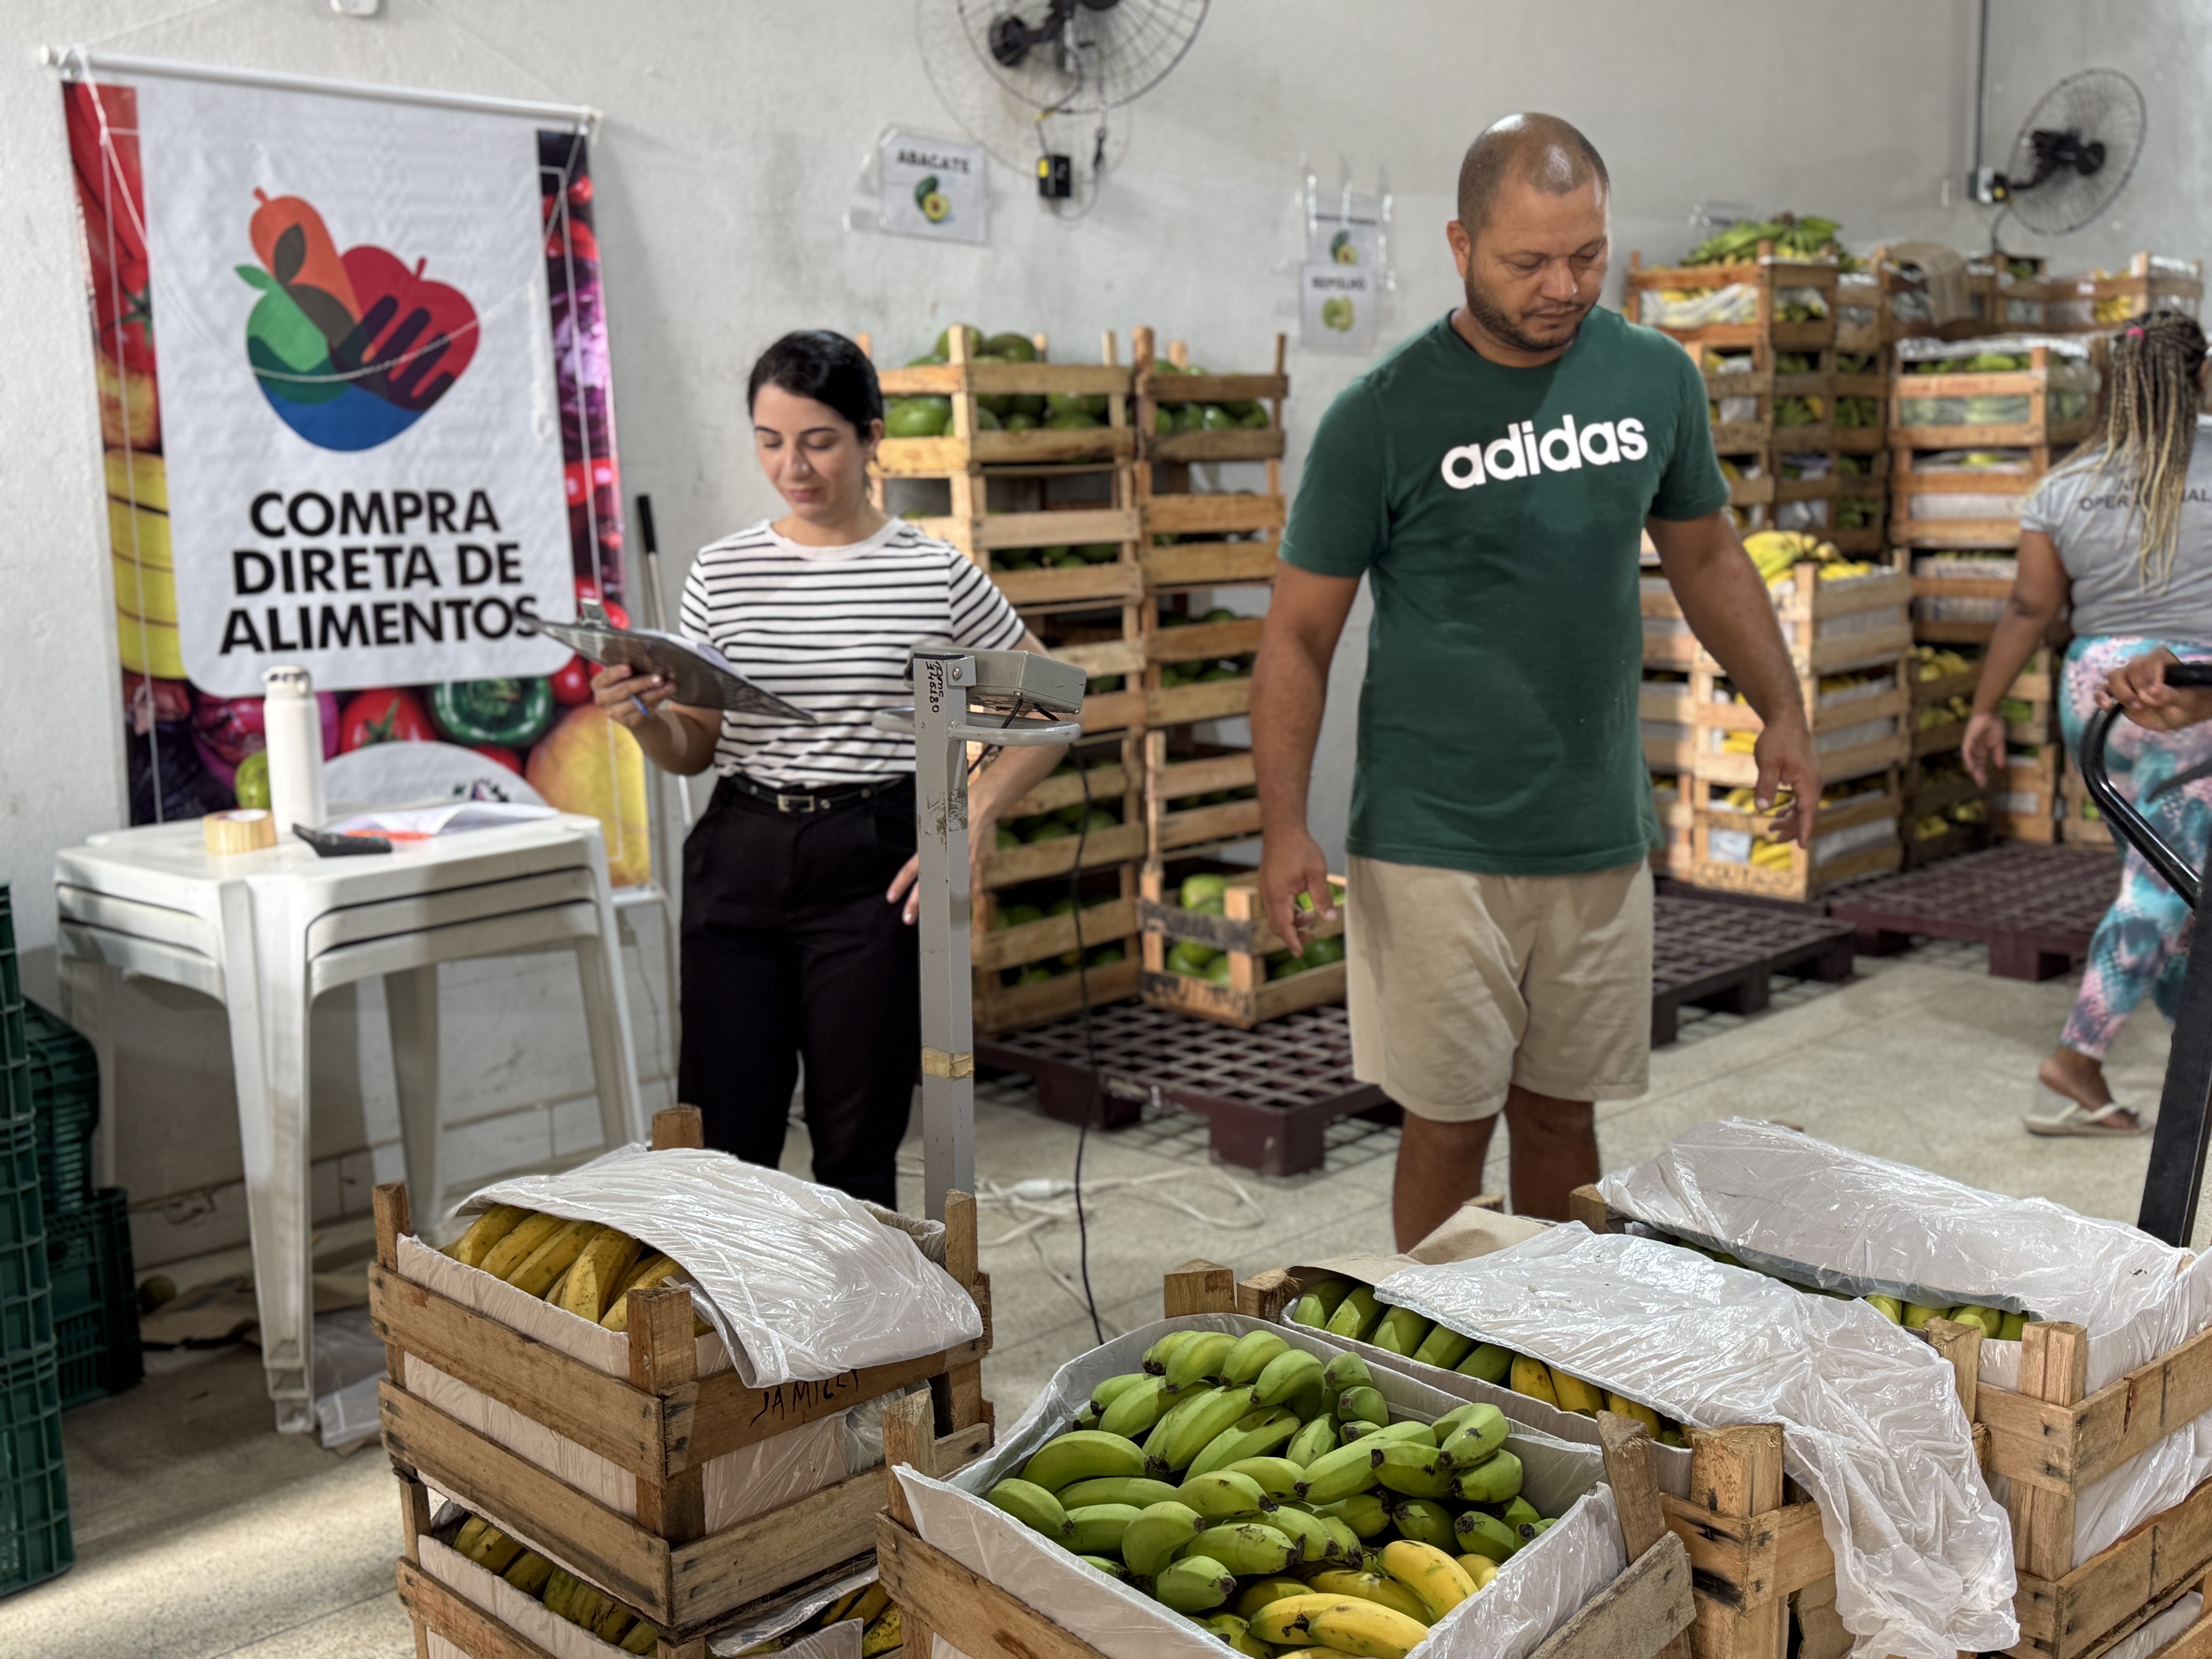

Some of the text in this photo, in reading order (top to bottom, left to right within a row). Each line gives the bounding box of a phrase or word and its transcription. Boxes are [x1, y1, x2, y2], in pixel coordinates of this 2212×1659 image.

[896, 149, 970, 175] ABACATE
[1441, 414, 1648, 489] adidas
[250, 490, 500, 538] COMPRA
[232, 543, 523, 596] DIRETA DE
[218, 595, 543, 656] ALIMENTOS
[925, 661, 939, 713] 145180
